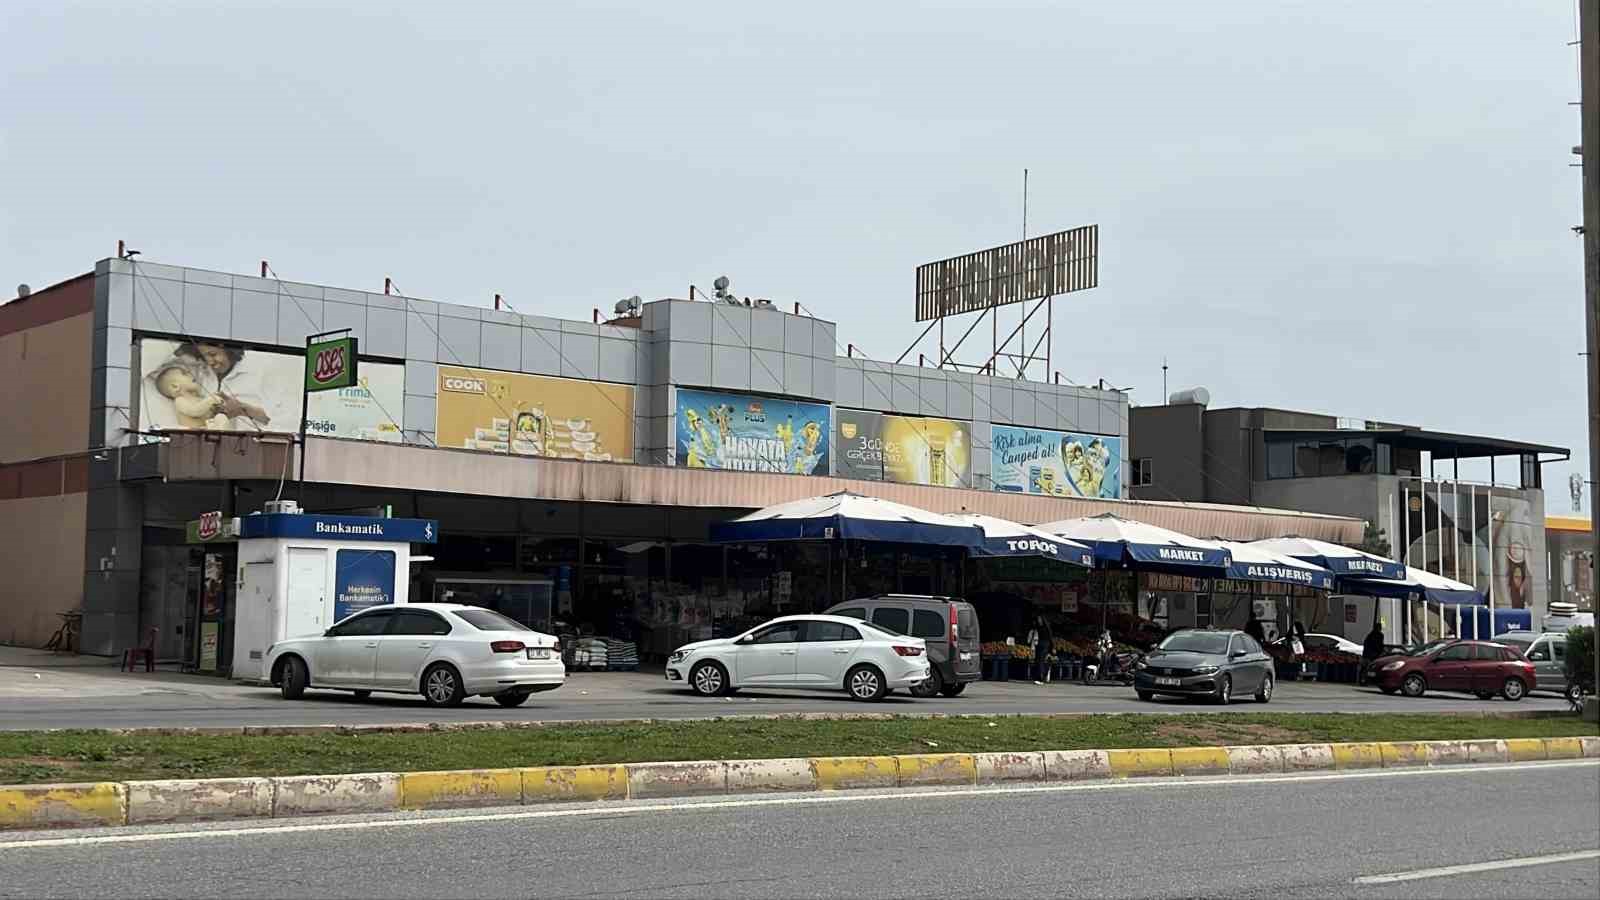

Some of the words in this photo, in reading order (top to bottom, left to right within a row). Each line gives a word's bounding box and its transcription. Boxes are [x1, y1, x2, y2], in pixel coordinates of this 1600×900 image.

[446, 378, 486, 392] COOK
[726, 436, 785, 461] HAYATA
[994, 433, 1014, 450] Risk
[1019, 432, 1042, 446] alma
[1002, 447, 1038, 467] Canped
[316, 521, 384, 535] Bankamatik
[1160, 548, 1204, 561] MARKET
